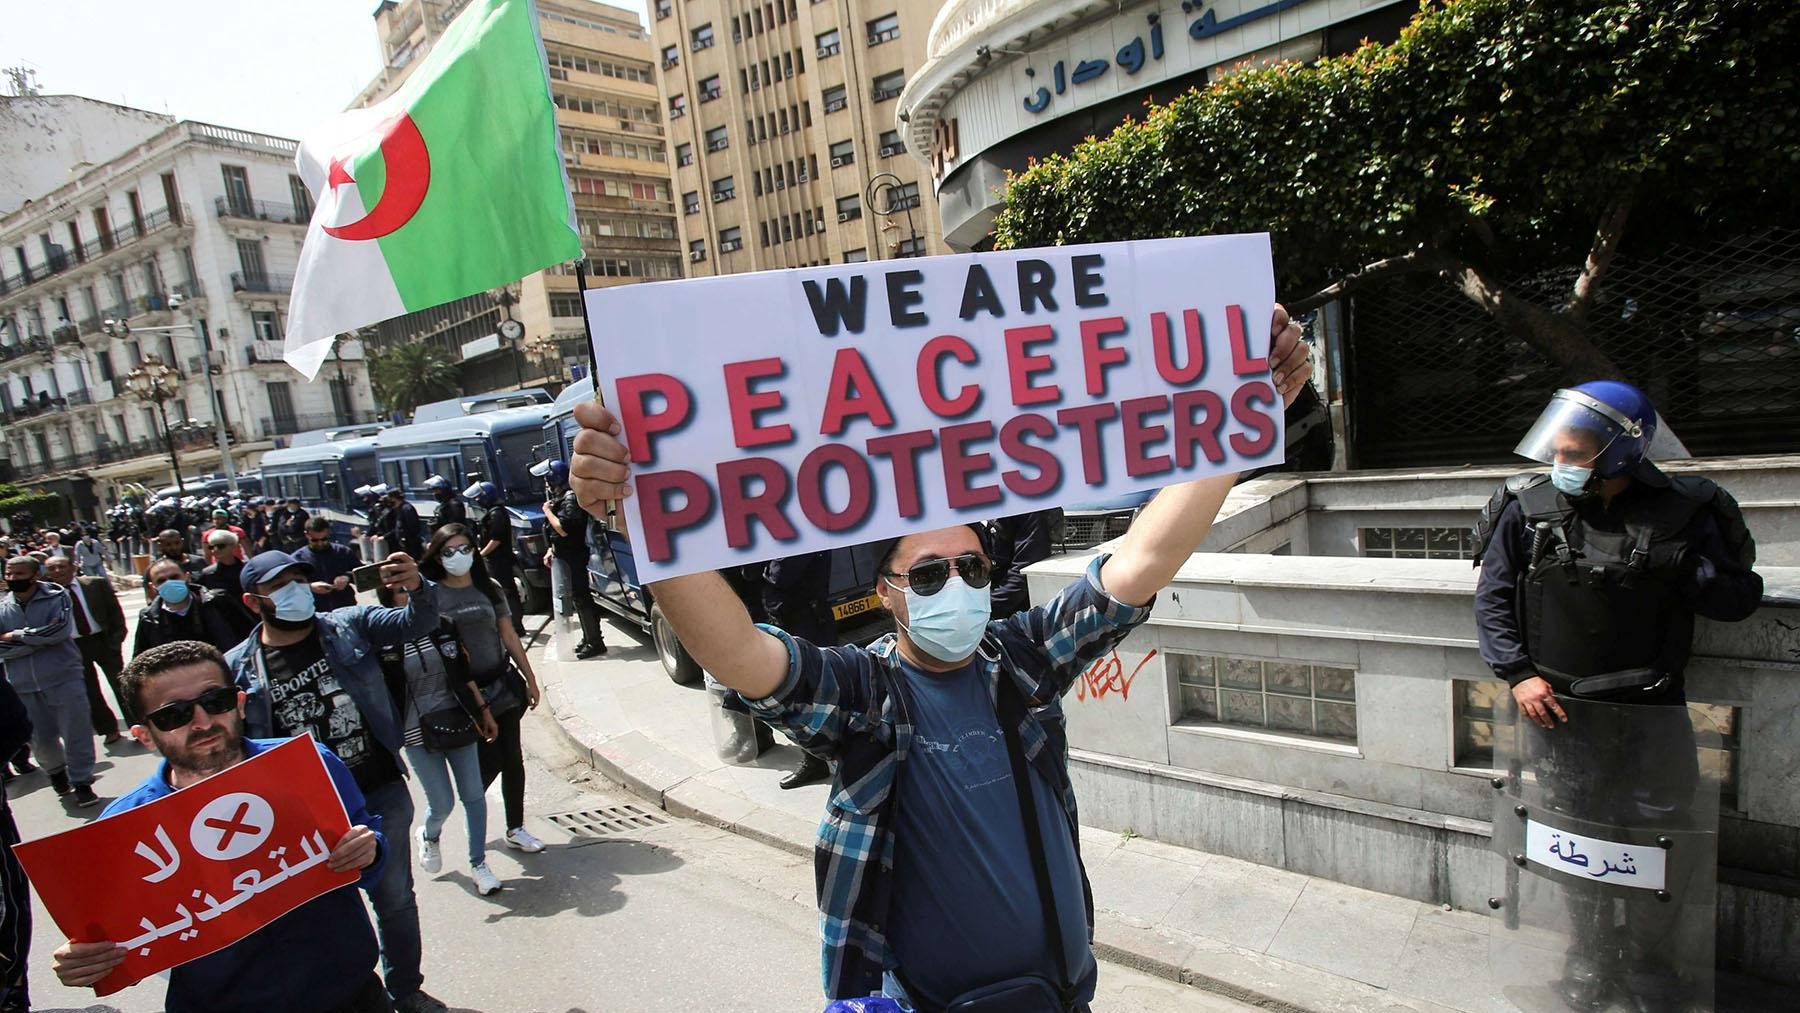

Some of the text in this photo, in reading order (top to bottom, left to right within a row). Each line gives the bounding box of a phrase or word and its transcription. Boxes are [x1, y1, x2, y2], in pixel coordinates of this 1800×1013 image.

[802, 254, 1106, 335] WE ARE
[615, 304, 1271, 464] PEACEFUL
[635, 381, 1277, 563] PROTESTERS
[270, 658, 330, 703] EPORTE
[134, 824, 181, 883] لا
[1549, 834, 1637, 877] شرطة
